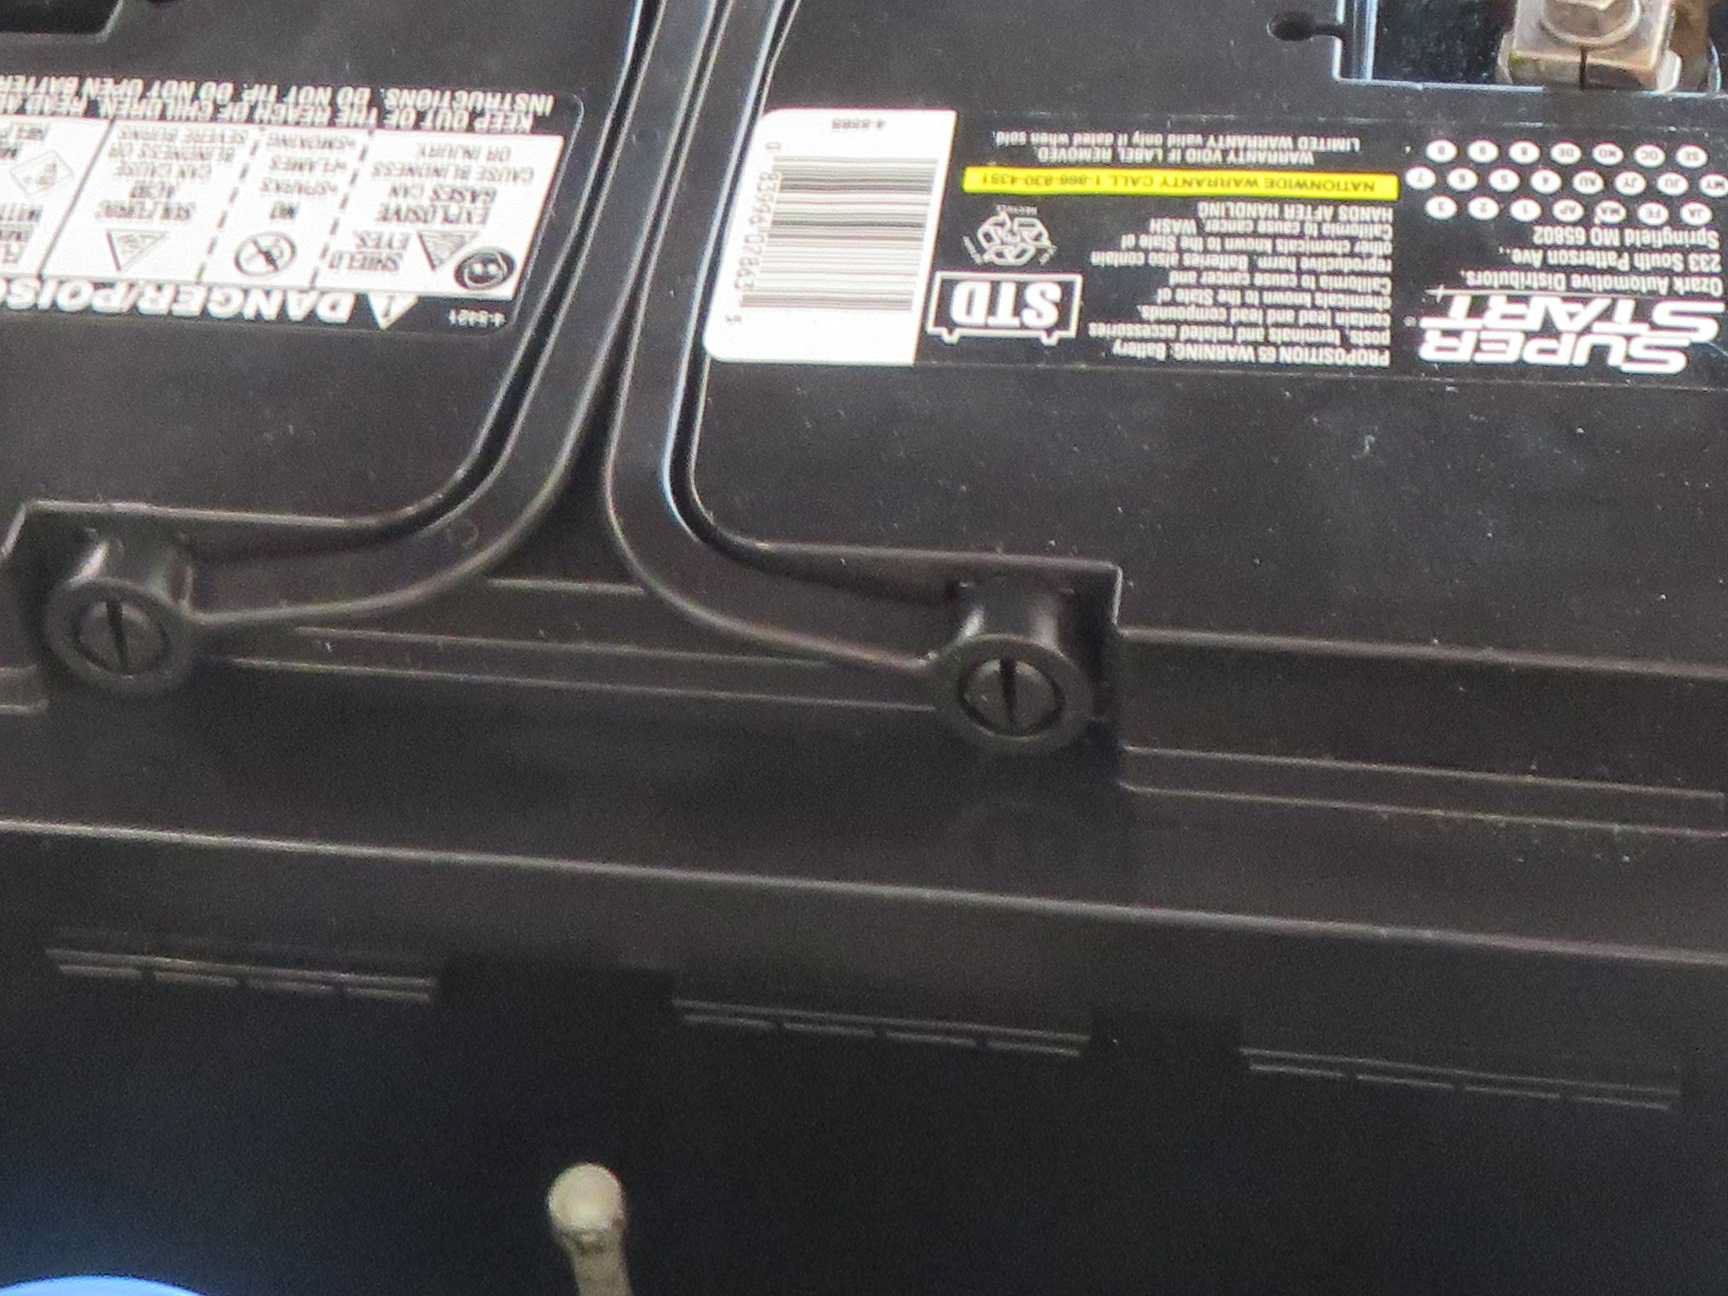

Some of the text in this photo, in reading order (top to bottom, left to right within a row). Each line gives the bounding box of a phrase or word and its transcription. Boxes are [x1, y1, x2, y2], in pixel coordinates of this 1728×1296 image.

[82, 77, 142, 99] OPEN
[147, 80, 194, 101] NOT
[198, 81, 233, 103] DO
[283, 85, 332, 108] NOT
[28, 96, 88, 116] READ
[337, 87, 371, 110] DO
[380, 88, 554, 114] INSTRUCTIONS.
[218, 102, 248, 120] OF
[255, 102, 331, 126] REACH
[336, 106, 377, 129] THE
[383, 107, 415, 130] OF
[421, 109, 469, 132] OUT
[473, 110, 534, 135] KEEP
[185, 129, 248, 146] SEVERE
[267, 133, 347, 150] SMOKING
[1031, 132, 1068, 146] when
[1072, 132, 1113, 148] dated
[1118, 133, 1128, 148] if
[1133, 130, 1163, 148] only
[1168, 133, 1202, 149] valid
[1208, 133, 1293, 150] WARRANTY
[1299, 136, 1359, 153] LIMITED
[108, 143, 235, 162] BLINDNESS OR
[485, 147, 511, 162] OR
[1118, 148, 1162, 163] LABEL
[1168, 148, 1181, 163] IF
[1188, 149, 1223, 164] VOID
[1226, 149, 1314, 165] WARRANTY
[113, 162, 211, 180] CAN CAUSE
[269, 157, 338, 173] FLAMES
[372, 162, 533, 180] CAUSE BLINDNESS
[260, 178, 329, 195] SPARKS
[1111, 174, 1154, 188] CALL
[1161, 175, 1258, 190] WARRANTY
[1264, 177, 1375, 192] NATIONWIDE
[388, 185, 496, 204] GASES CAN
[375, 203, 490, 224] EXPLOSIVE
[1198, 201, 1393, 222] HANDS AFTER HANDLING
[1149, 218, 1197, 234] WASH
[1258, 220, 1300, 234] cause
[1304, 221, 1317, 236] to
[1323, 222, 1393, 239] California
[1121, 234, 1392, 255] other chemicals known to the State of
[1533, 225, 1719, 248] Springfield MO 65802
[328, 251, 403, 272] SHIELD
[1091, 251, 1145, 267] contain
[1149, 252, 1178, 268] also
[1183, 253, 1248, 271] Batteries
[1300, 254, 1392, 274] reproductive
[1548, 250, 1629, 270] Patterson
[1634, 252, 1684, 271] South
[1688, 253, 1721, 272] 233
[1170, 270, 1392, 294] California to cause cancer and
[1573, 274, 1668, 294] Automotive
[1674, 276, 1722, 296] Ozark
[950, 280, 1062, 328] STD
[1157, 288, 1391, 310] chemicals known to the State of
[1231, 308, 1263, 324] lead
[1268, 310, 1295, 325] and
[1299, 310, 1331, 327] lead
[1335, 311, 1391, 328] contain
[1420, 295, 1725, 342] START
[1089, 323, 1176, 338] accessories
[1180, 325, 1233, 341] related
[1237, 326, 1264, 343] and
[1268, 328, 1340, 345] terminals
[1112, 339, 1391, 366] PROPOSITION 65 WARNING: Battery
[1418, 330, 1691, 373] SUPER
